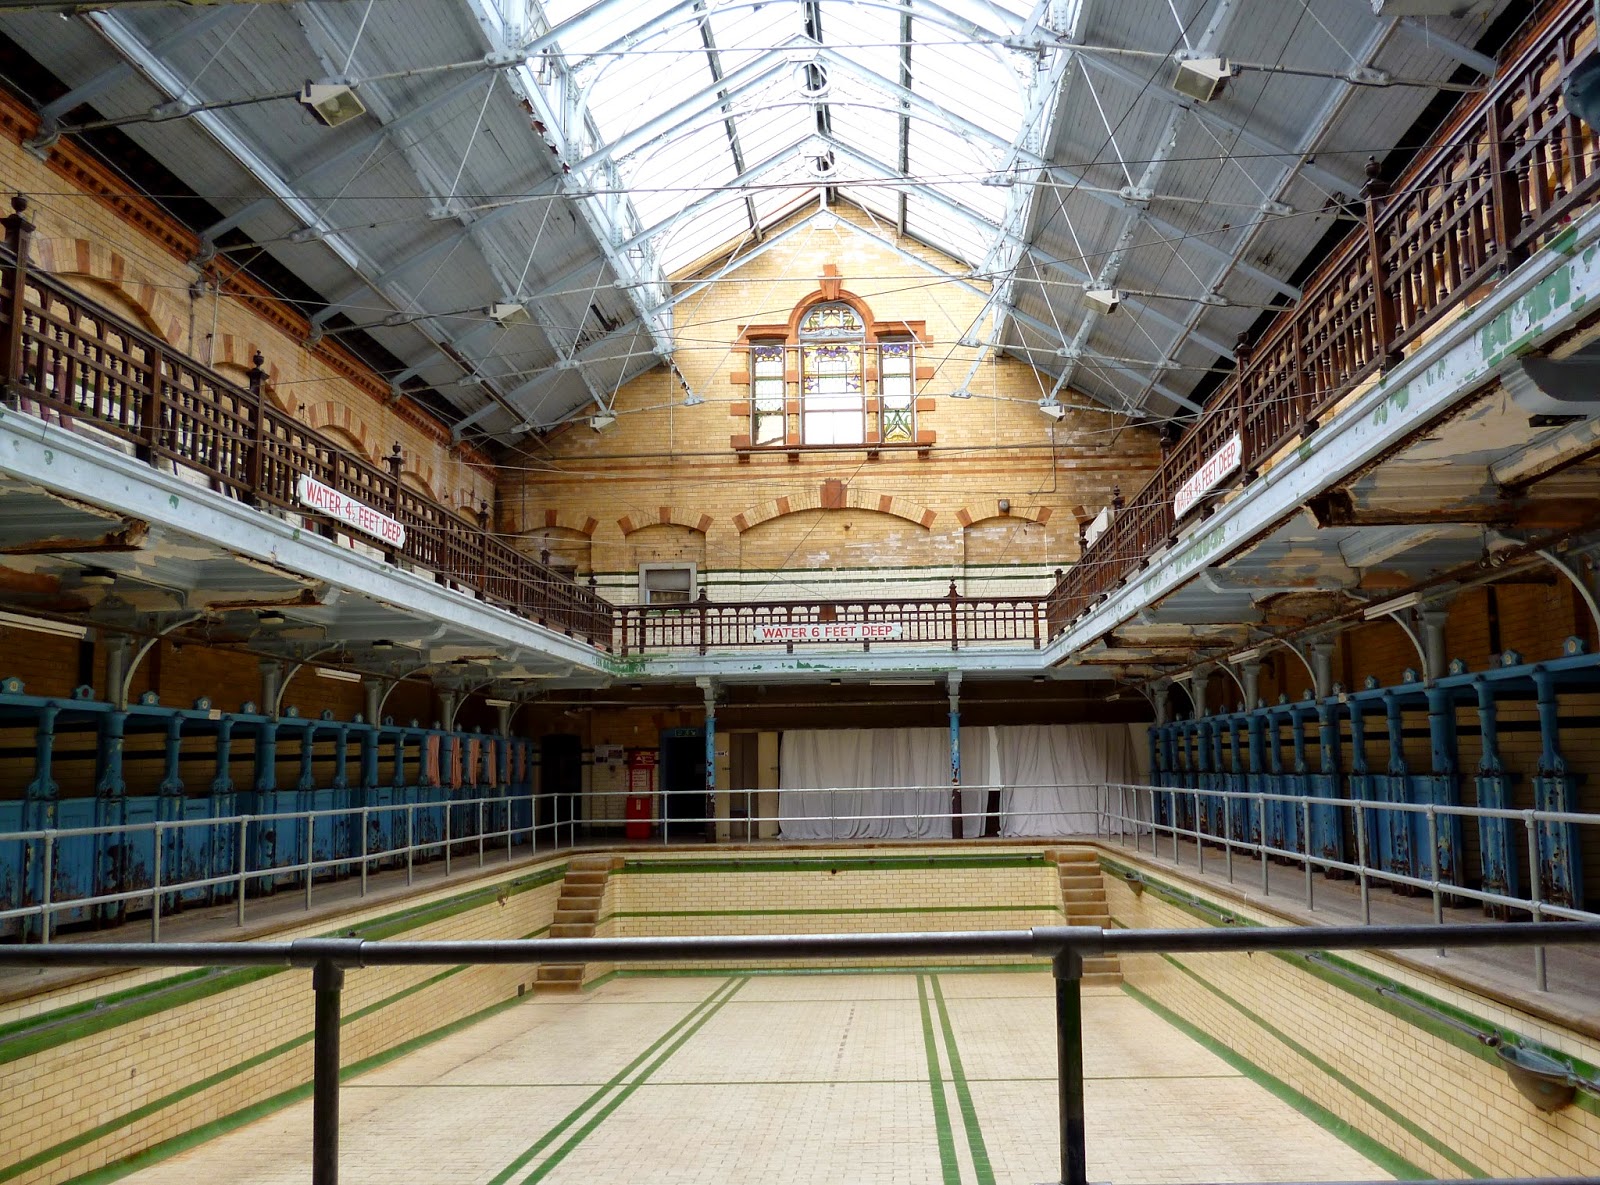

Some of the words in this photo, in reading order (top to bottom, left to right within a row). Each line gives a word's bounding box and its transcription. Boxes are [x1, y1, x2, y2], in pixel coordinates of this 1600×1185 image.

[1176, 482, 1193, 512] WATER
[1202, 459, 1217, 490] FEET
[1218, 442, 1236, 475] DEEP
[306, 480, 341, 516] WATER
[358, 506, 380, 534] FEET
[382, 518, 401, 543] DEEP
[763, 627, 807, 638] WATER
[811, 626, 820, 637] 6
[825, 626, 857, 637] FEET
[862, 625, 893, 636] DEEP
